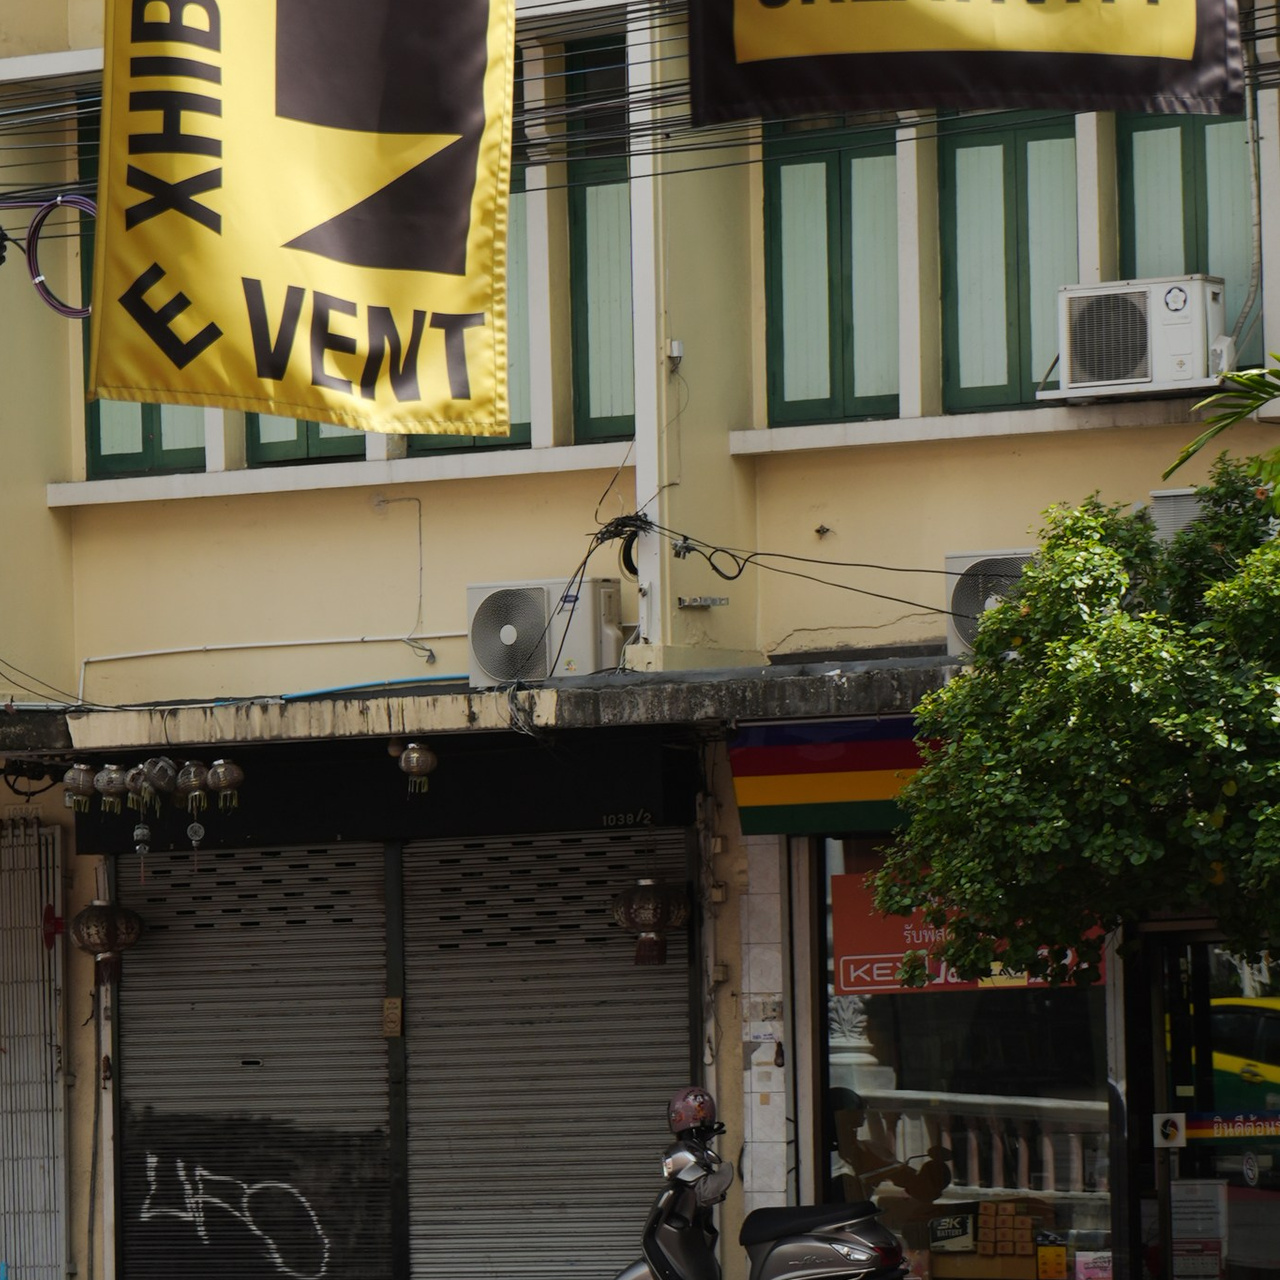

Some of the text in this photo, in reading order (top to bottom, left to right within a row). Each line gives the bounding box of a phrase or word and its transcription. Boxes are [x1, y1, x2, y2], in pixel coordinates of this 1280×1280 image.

[601, 807, 652, 827] 1038/2
[903, 924, 957, 945] รับพัสด
